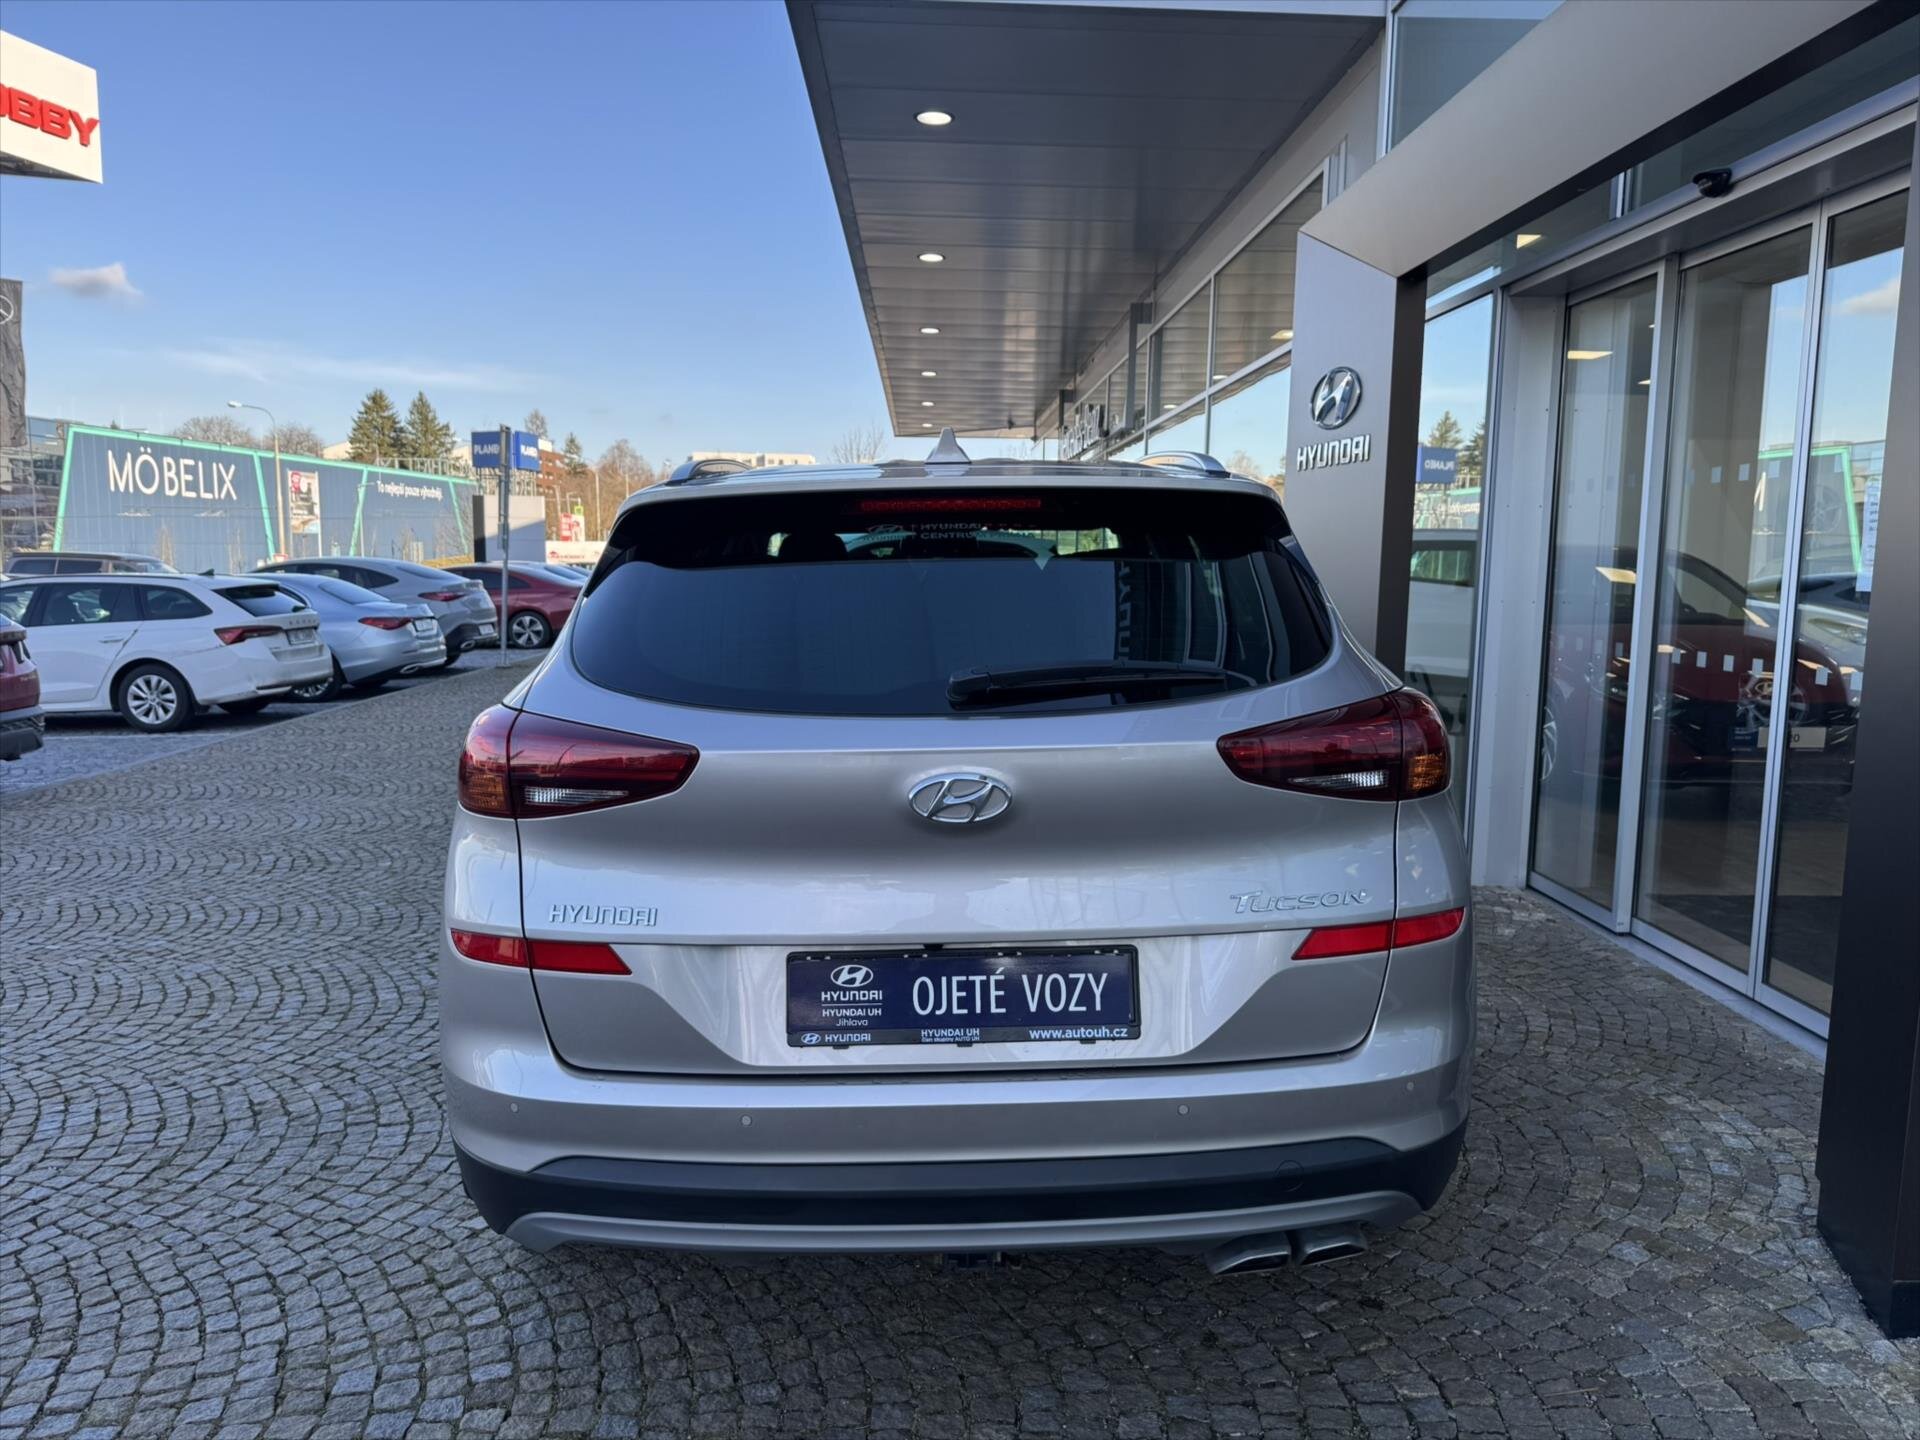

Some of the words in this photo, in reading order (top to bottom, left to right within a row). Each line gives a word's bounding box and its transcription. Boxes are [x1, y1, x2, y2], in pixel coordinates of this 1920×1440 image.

[0, 82, 100, 147] BBY
[1297, 434, 1370, 472] HYUNDAI
[107, 446, 238, 500] MÖBELIX
[1230, 889, 1371, 914] TUCSON
[549, 904, 658, 927] HYUNDAI
[821, 990, 883, 1001] HYUNDAI
[912, 967, 1006, 1015] OJETÉ
[1022, 972, 1108, 1013] VOZY
[822, 1008, 866, 1017] HYUNDAI
[867, 1008, 882, 1016] UH
[836, 1018, 868, 1026] Jihlava
[825, 1033, 871, 1042] HYUNDAI
[921, 1028, 964, 1037] HYUNDAI
[966, 1028, 980, 1036] UH
[1029, 1026, 1129, 1040] www.autouh.cz
